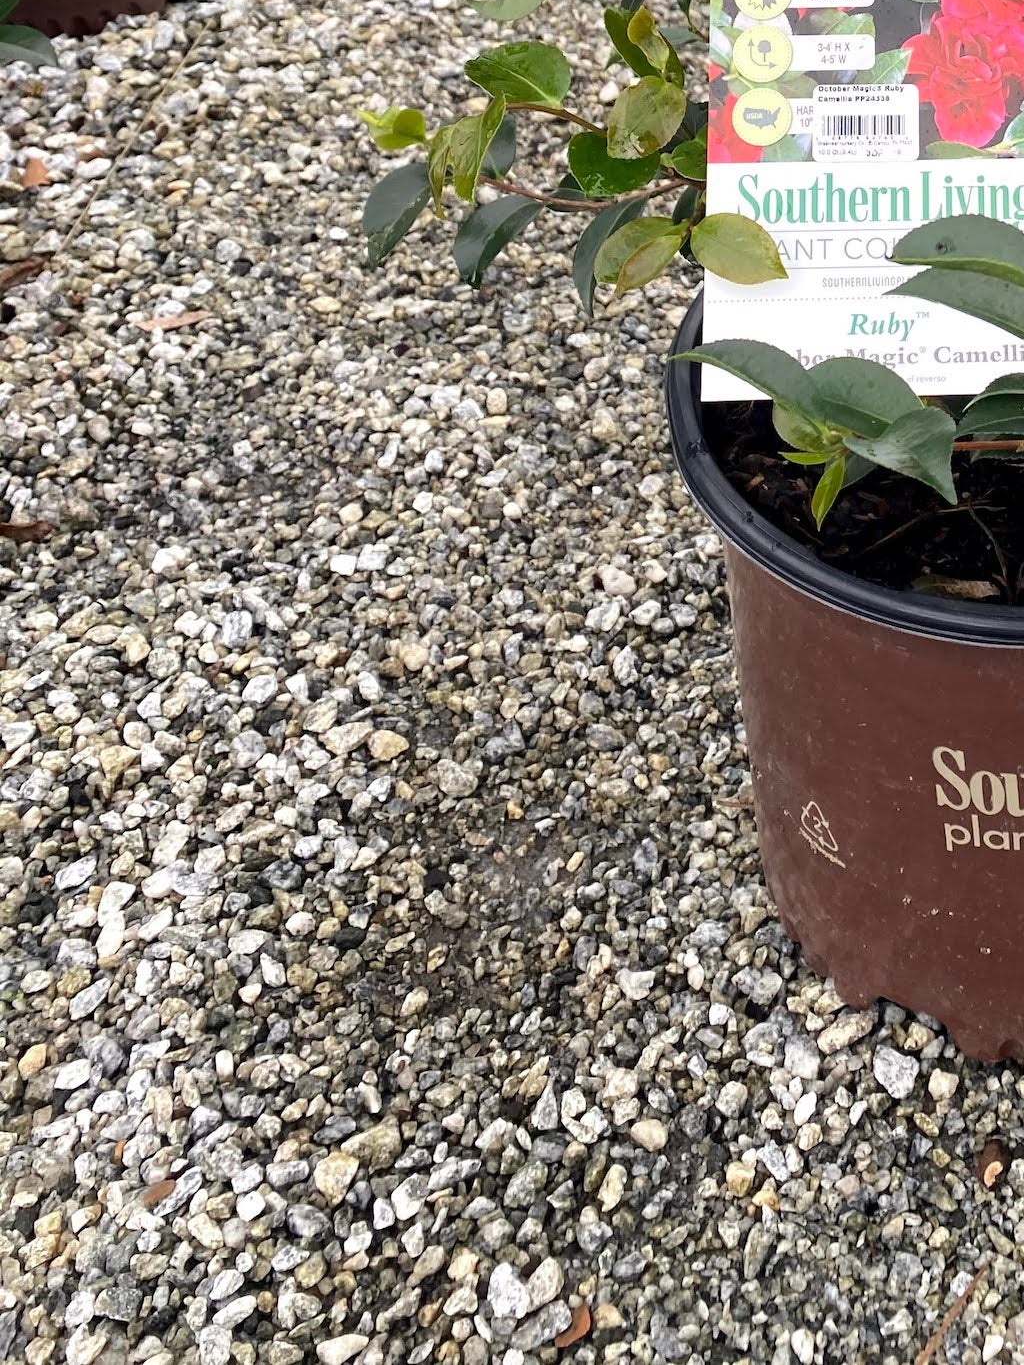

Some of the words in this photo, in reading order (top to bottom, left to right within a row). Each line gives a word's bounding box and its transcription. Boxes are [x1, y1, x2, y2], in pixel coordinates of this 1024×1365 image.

[885, 85, 904, 93] Ruby
[796, 105, 813, 116] HAR
[746, 112, 764, 121] USDA
[738, 172, 912, 225] Southern
[777, 239, 834, 261] ANT
